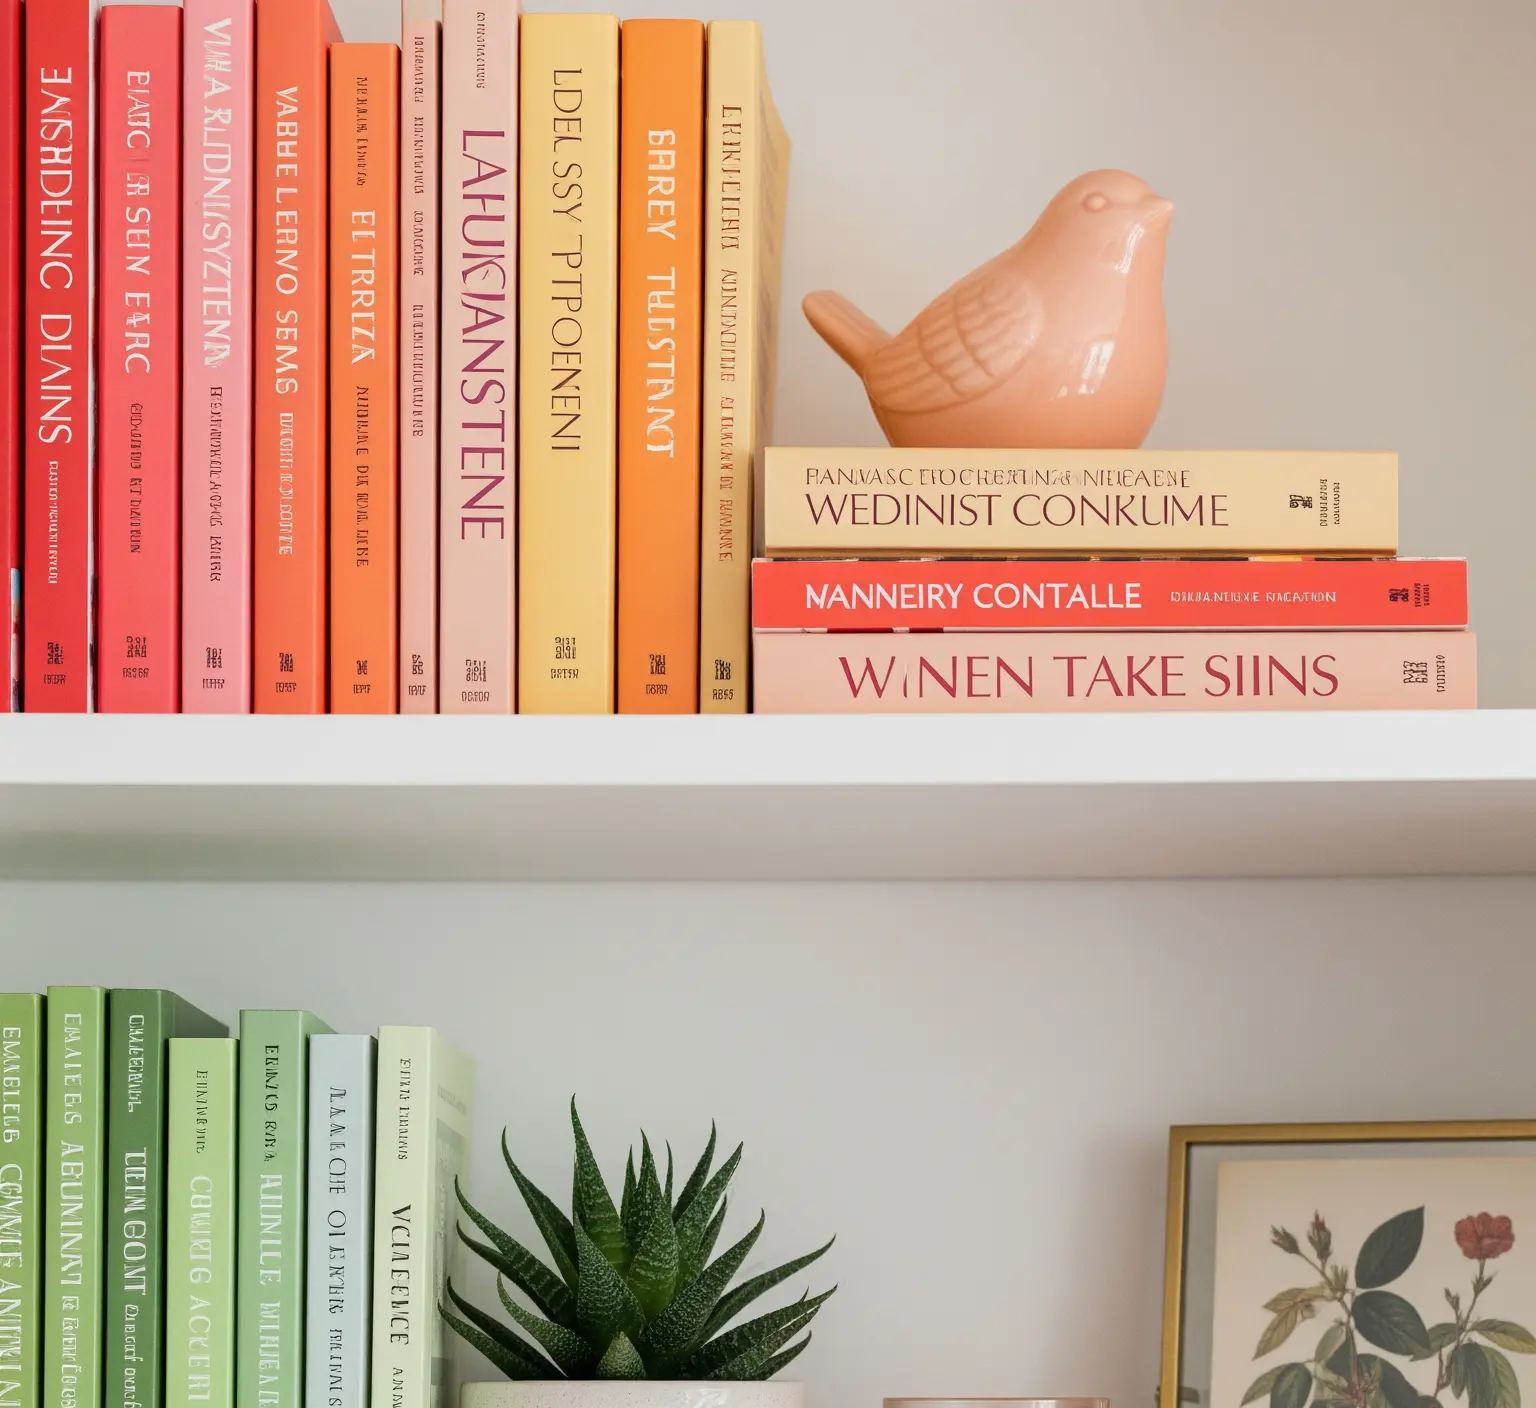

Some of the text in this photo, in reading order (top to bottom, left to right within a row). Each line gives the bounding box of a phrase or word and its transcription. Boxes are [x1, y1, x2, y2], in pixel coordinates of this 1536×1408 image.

[806, 494, 1001, 526] WEDINIST
[974, 583, 1141, 608] CONTALLE
[1053, 656, 1186, 697] TAKE
[1205, 655, 1338, 696] SIINS
